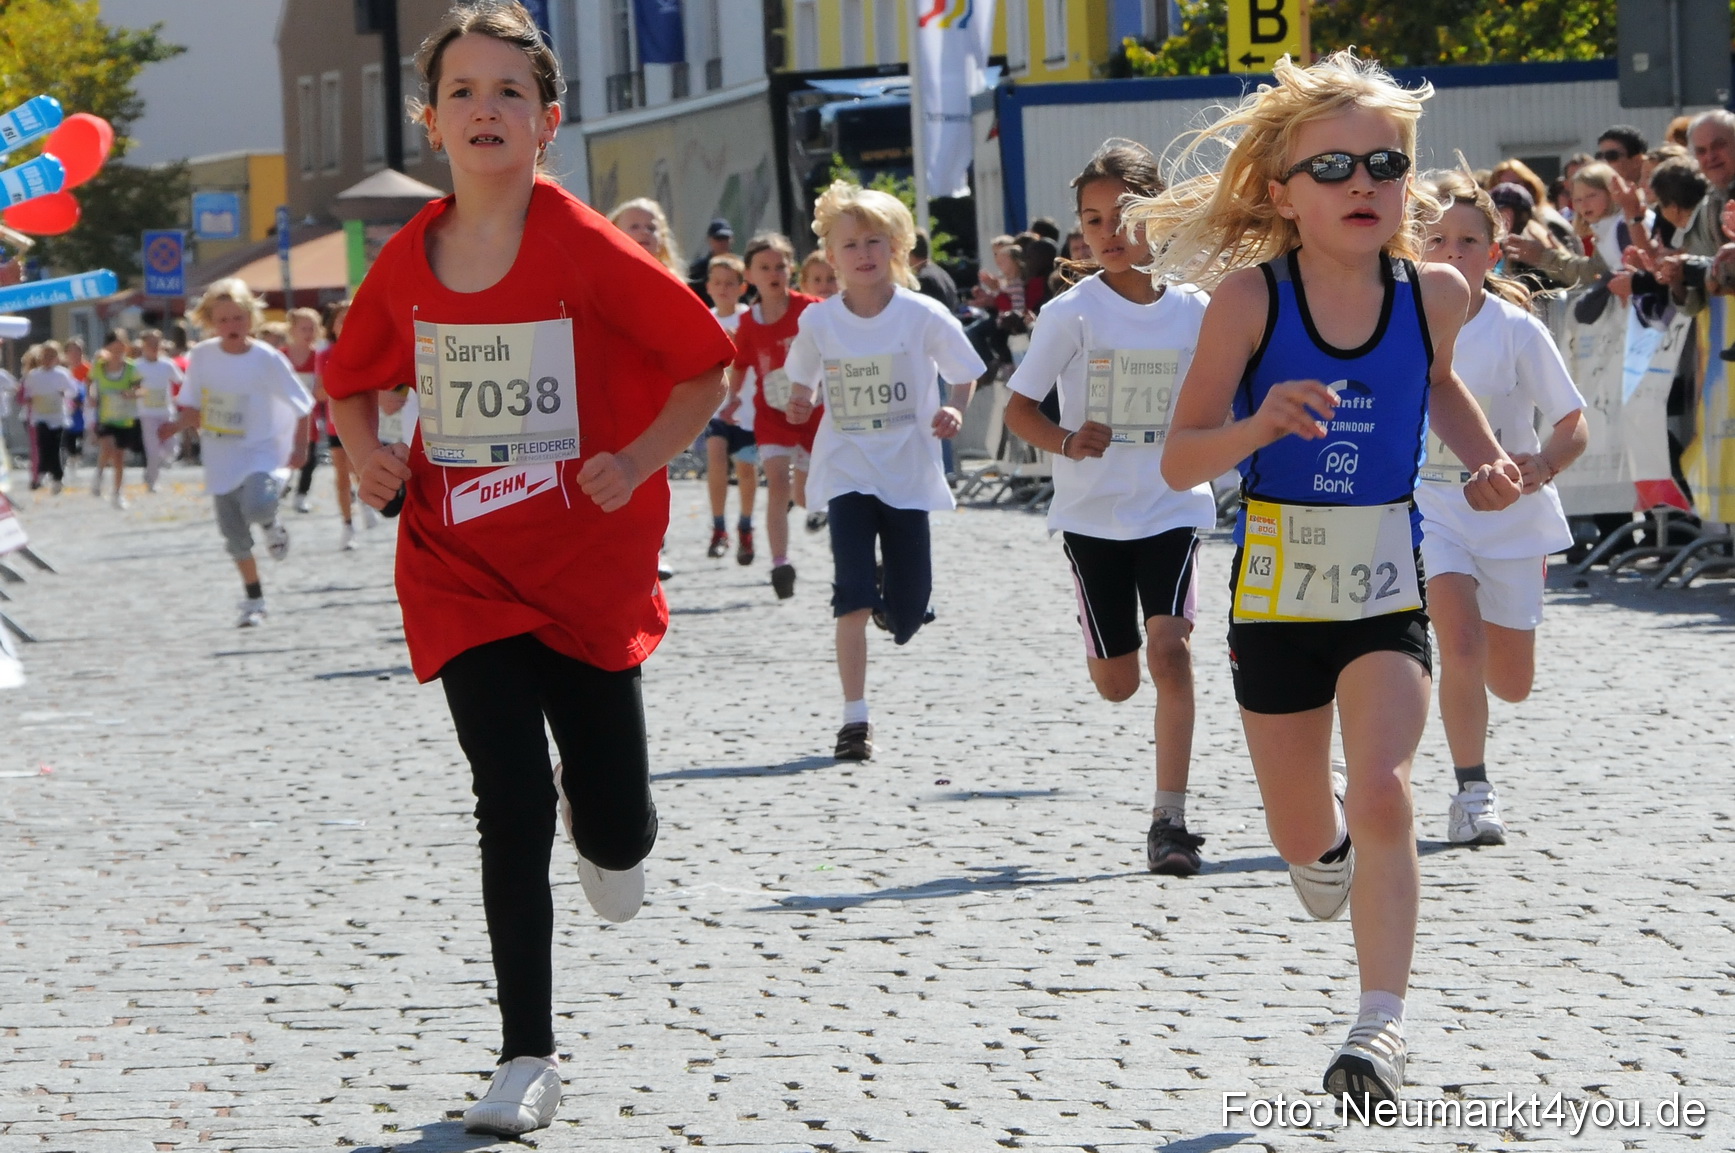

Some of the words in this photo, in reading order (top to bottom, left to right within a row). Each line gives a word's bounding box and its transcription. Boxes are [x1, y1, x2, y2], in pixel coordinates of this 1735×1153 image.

[1249, 0, 1288, 44] B
[150, 275, 182, 290] TAXI
[444, 335, 511, 362] Sarah
[844, 362, 880, 378] Sarah
[1120, 356, 1179, 375] Vanessa
[420, 375, 434, 395] K3
[849, 381, 907, 407] 7190
[1091, 383, 1107, 398] K3
[449, 376, 562, 419] 7038
[1120, 386, 1173, 413] 719
[1331, 421, 1376, 433] ZIRNDORF
[510, 438, 576, 455] PFLEIDERER
[1325, 452, 1359, 475] psd
[480, 472, 526, 504] DEHN
[1313, 474, 1355, 495] Bank
[1288, 516, 1326, 546] Lea
[1249, 555, 1273, 577] K3
[1293, 561, 1401, 605] 7132
